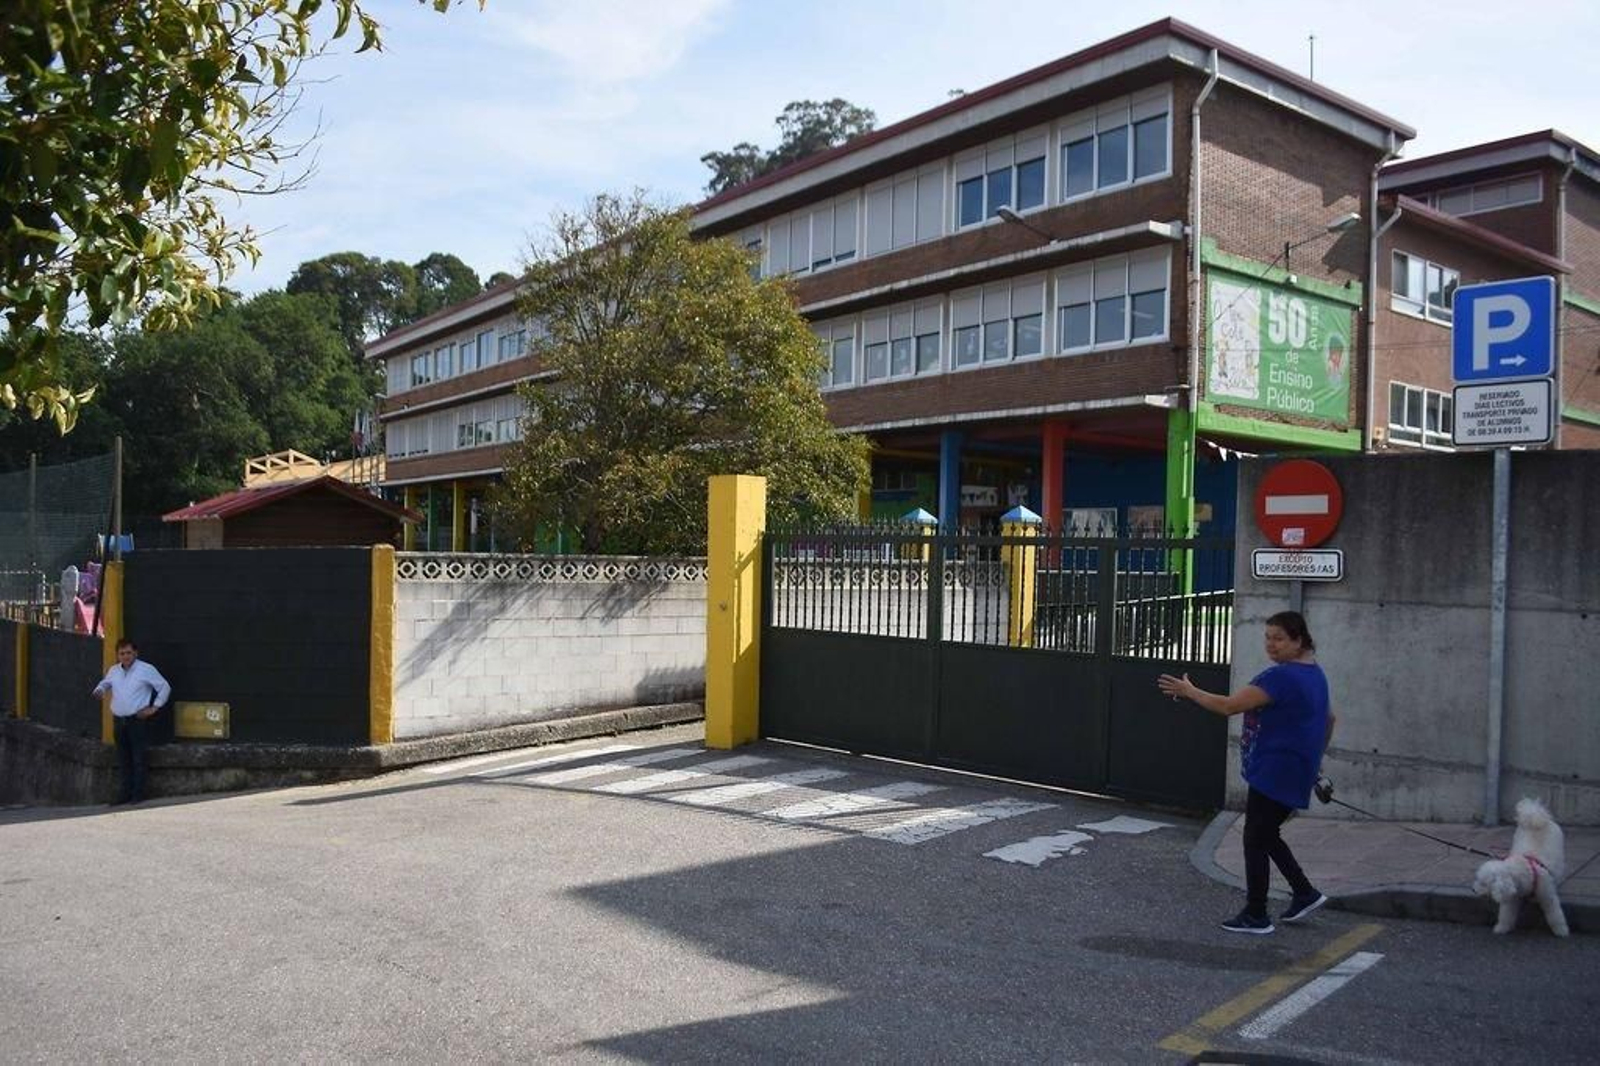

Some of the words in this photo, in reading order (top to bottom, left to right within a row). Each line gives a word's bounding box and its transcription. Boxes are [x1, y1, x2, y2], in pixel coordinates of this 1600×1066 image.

[1268, 289, 1307, 348] 50
[1473, 294, 1531, 371] P
[1285, 348, 1299, 364] de
[1269, 363, 1313, 390] Ensino
[1266, 387, 1315, 413] Público
[1479, 390, 1520, 400] RESERVADO
[1492, 399, 1525, 408] LECTIVOS
[1462, 409, 1506, 419] TRANSPORTE
[1507, 407, 1538, 416] PRIVADO
[1477, 419, 1487, 427] DE
[1488, 417, 1522, 426] ALUMNOS
[1467, 428, 1476, 436] DE
